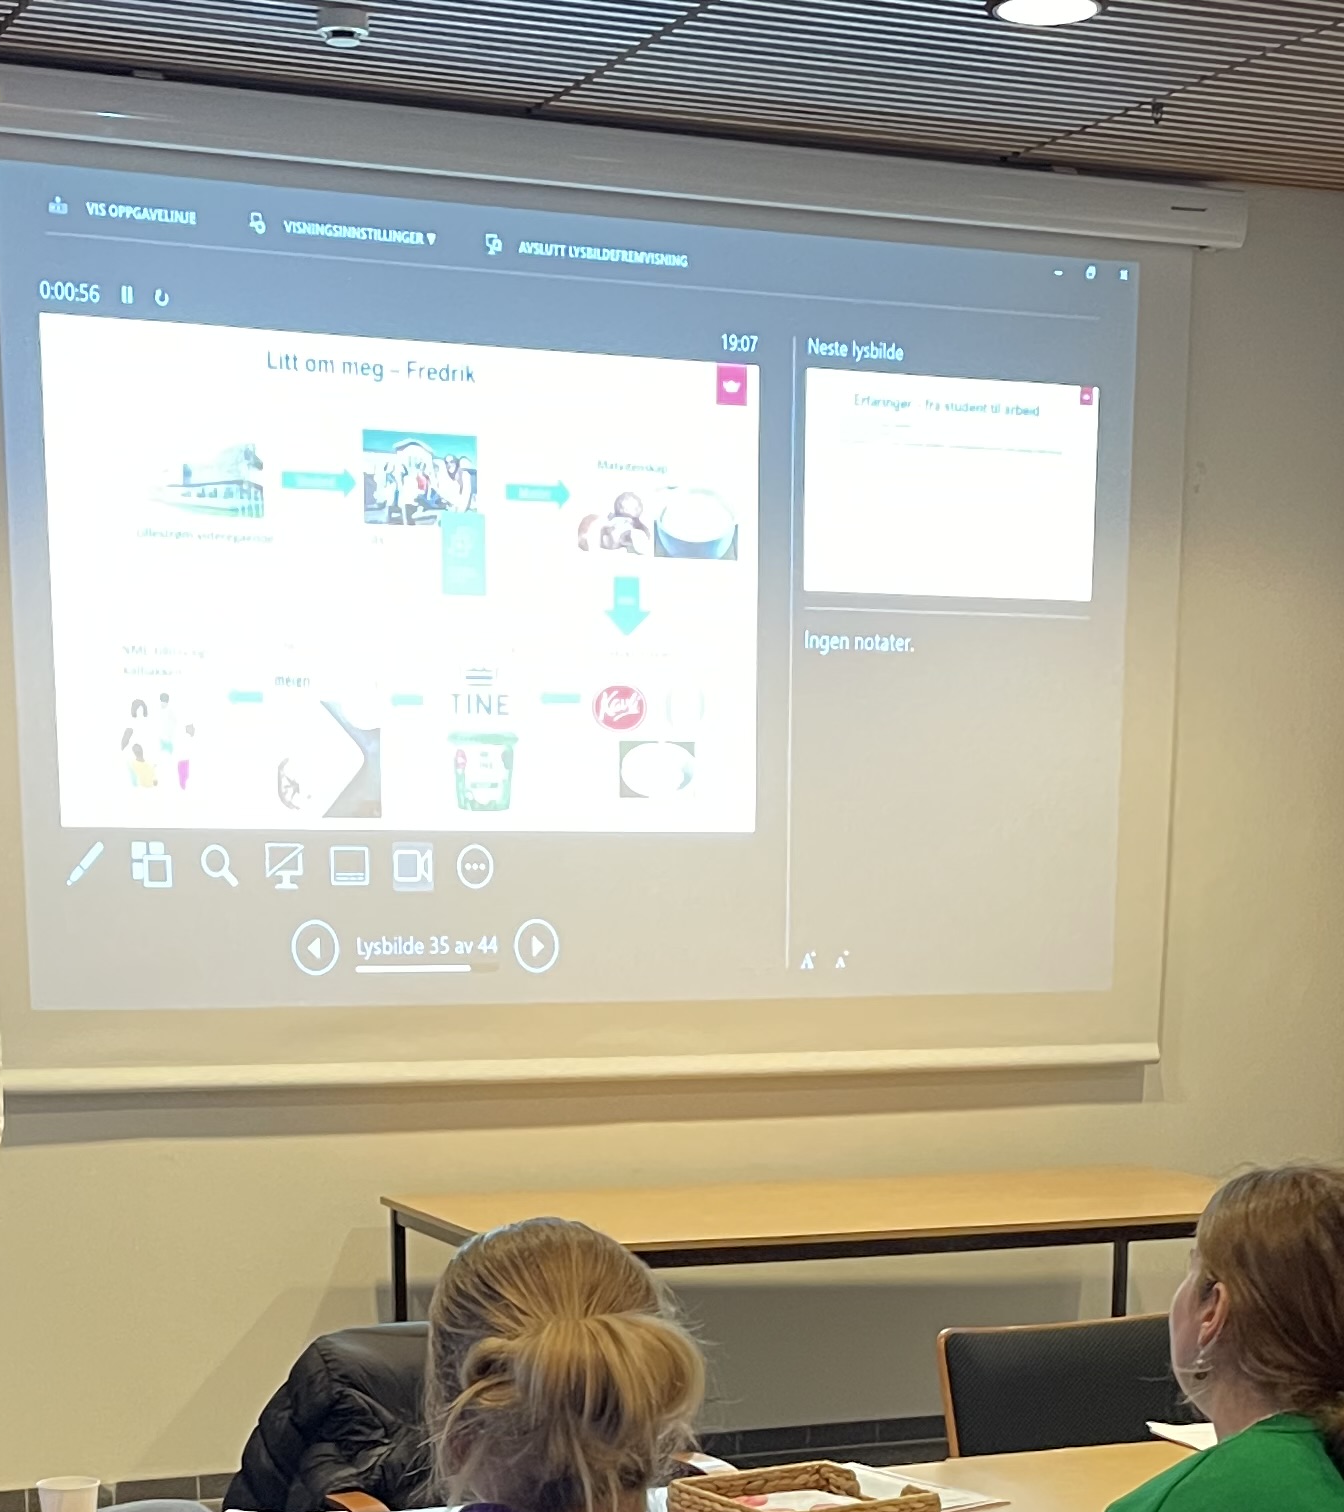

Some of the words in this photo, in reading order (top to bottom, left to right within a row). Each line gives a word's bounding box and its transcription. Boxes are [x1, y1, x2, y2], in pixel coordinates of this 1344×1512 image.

[85, 201, 107, 217] VIS
[108, 203, 197, 225] OPPGAVELINJE
[283, 219, 425, 246] VISNINGSINNSTILLINGER
[518, 241, 566, 258] AVSLUTT
[568, 244, 689, 268] LYSBILDEFREMVISNING
[38, 279, 101, 304] 0:00:56
[719, 331, 759, 354] 19:07
[806, 337, 849, 357] Neste
[851, 340, 905, 363] lysbilde
[266, 350, 299, 373] Litt
[304, 358, 336, 374] om
[342, 358, 385, 385] meg
[406, 359, 476, 385] Fredrik
[803, 630, 850, 656] Ingen
[854, 633, 915, 653] notater.
[451, 693, 510, 716] TINE
[356, 934, 424, 961] Lysbilde
[429, 935, 451, 956] 35
[454, 940, 474, 956] av
[476, 935, 499, 956] 44
